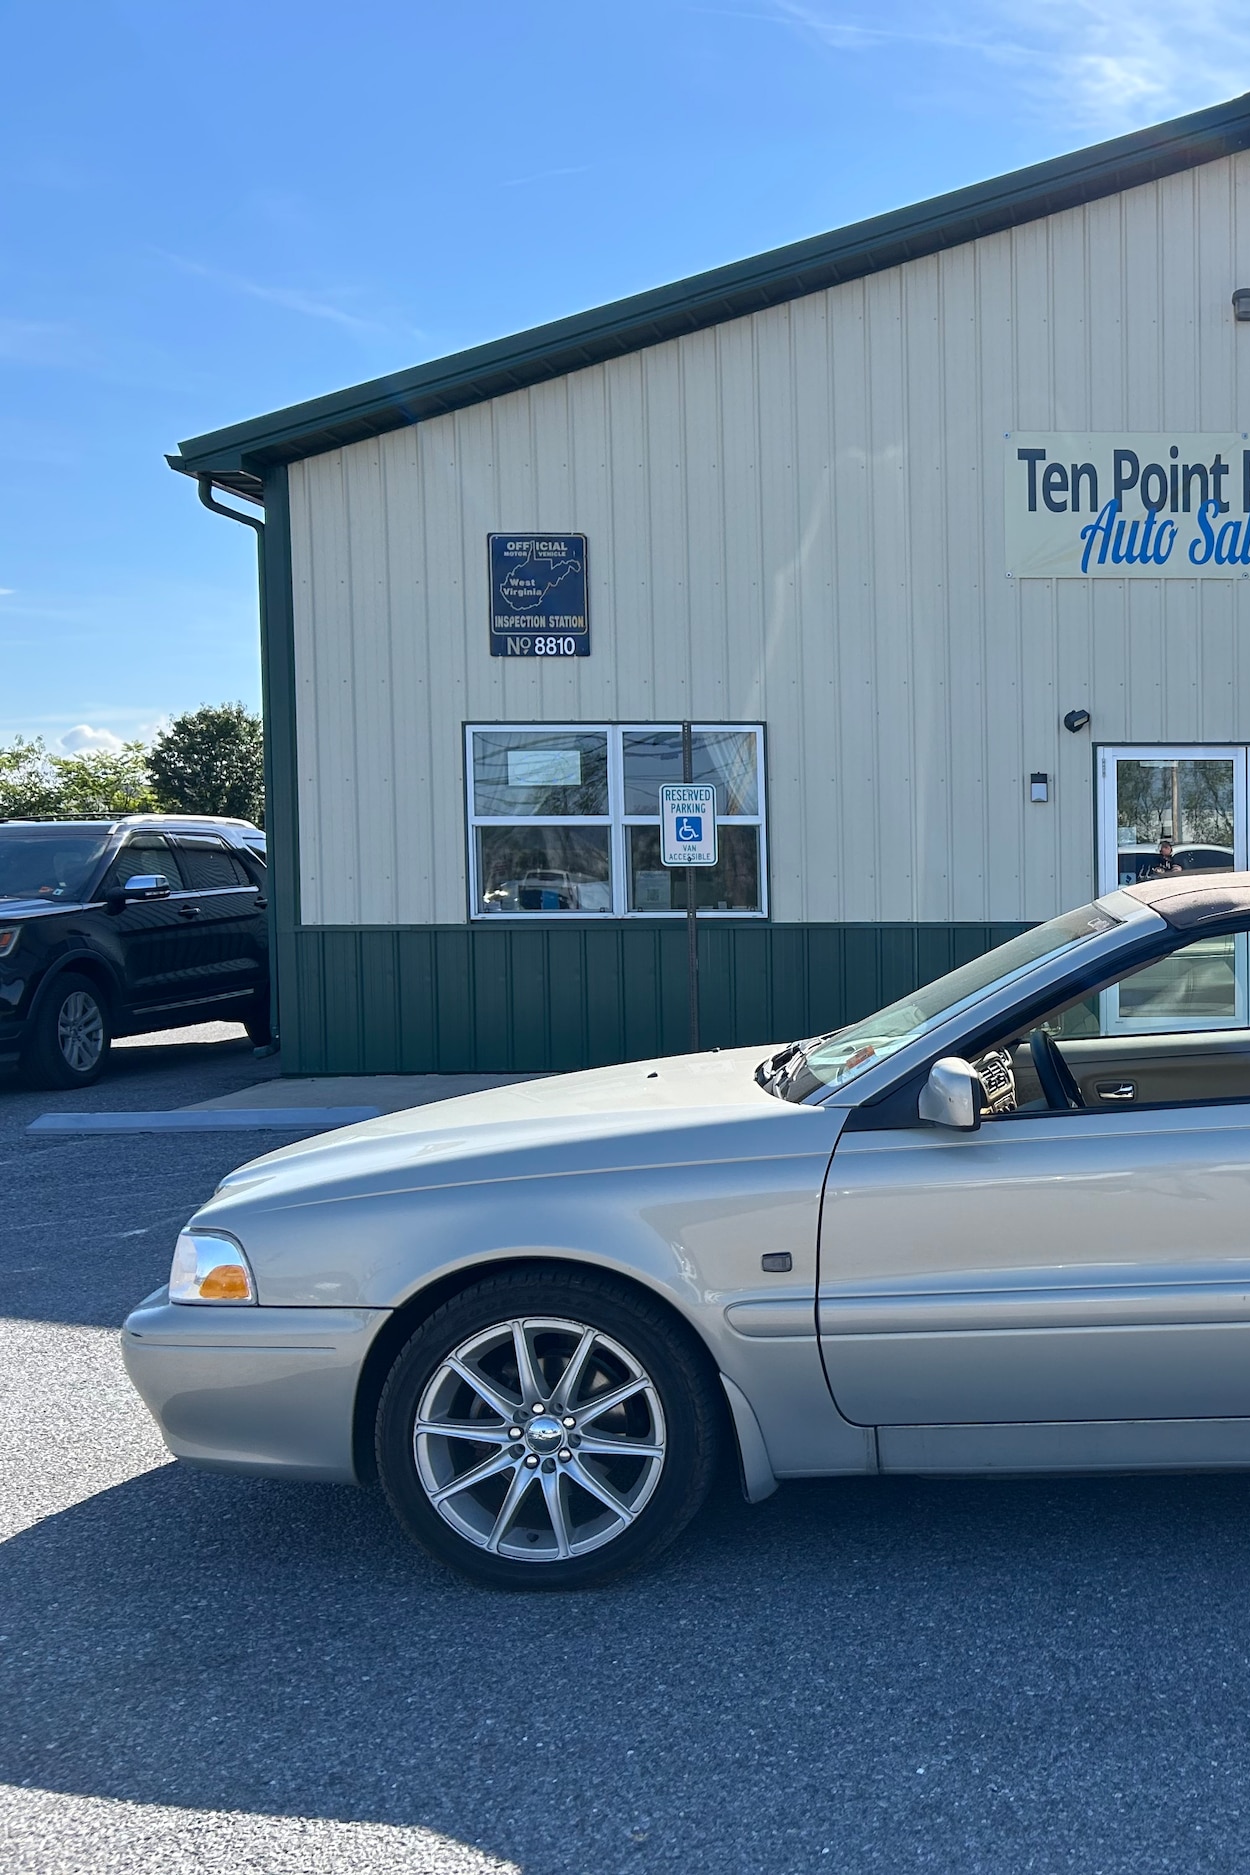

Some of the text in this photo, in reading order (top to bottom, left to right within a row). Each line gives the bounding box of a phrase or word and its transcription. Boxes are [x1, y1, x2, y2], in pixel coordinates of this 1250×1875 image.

[1017, 448, 1098, 512] Ten
[1113, 445, 1229, 514] Point
[1080, 498, 1178, 574] Auto
[507, 541, 568, 551] OFFICIAL
[509, 578, 536, 587] West
[503, 588, 542, 597] Virginia
[495, 615, 584, 628] INSPECTION STATION
[535, 636, 576, 655] 8810
[665, 789, 711, 801] RESERVED
[671, 803, 706, 814] PARKING
